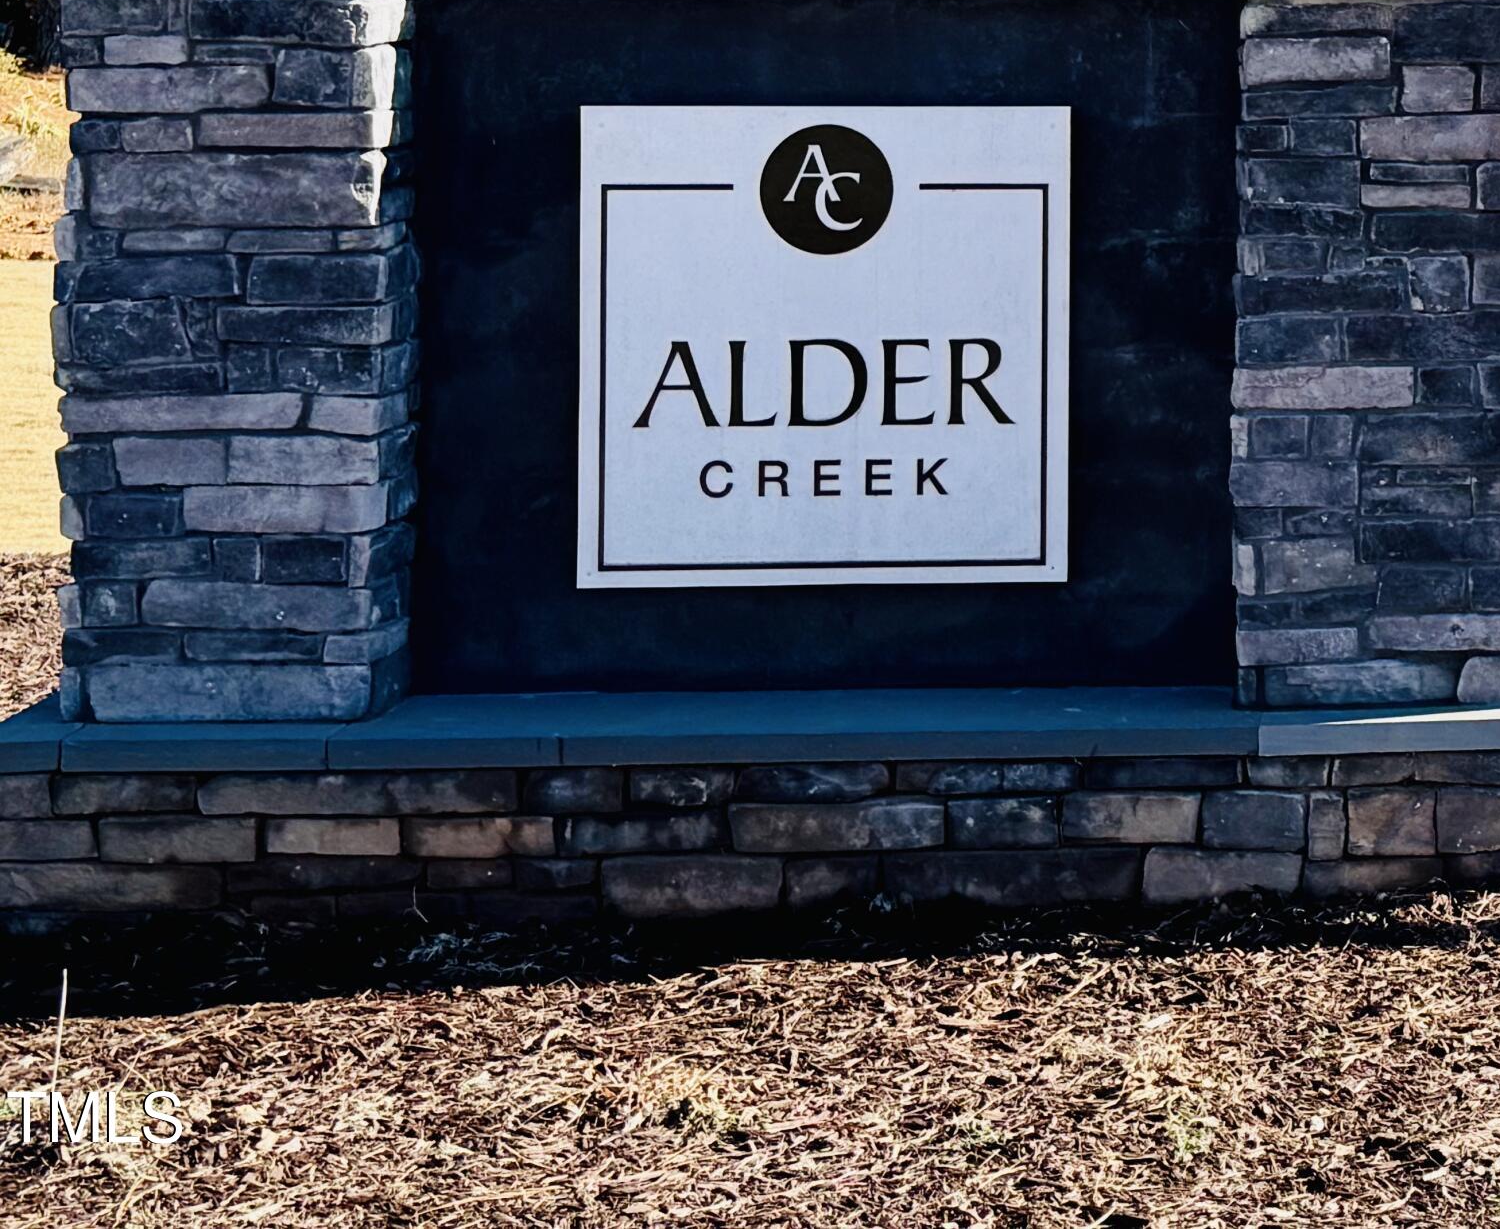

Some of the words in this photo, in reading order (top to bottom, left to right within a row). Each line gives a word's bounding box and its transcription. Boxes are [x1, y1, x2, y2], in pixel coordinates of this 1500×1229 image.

[783, 144, 863, 231] AC
[632, 338, 1017, 428] ALDER
[699, 457, 949, 499] CREEK
